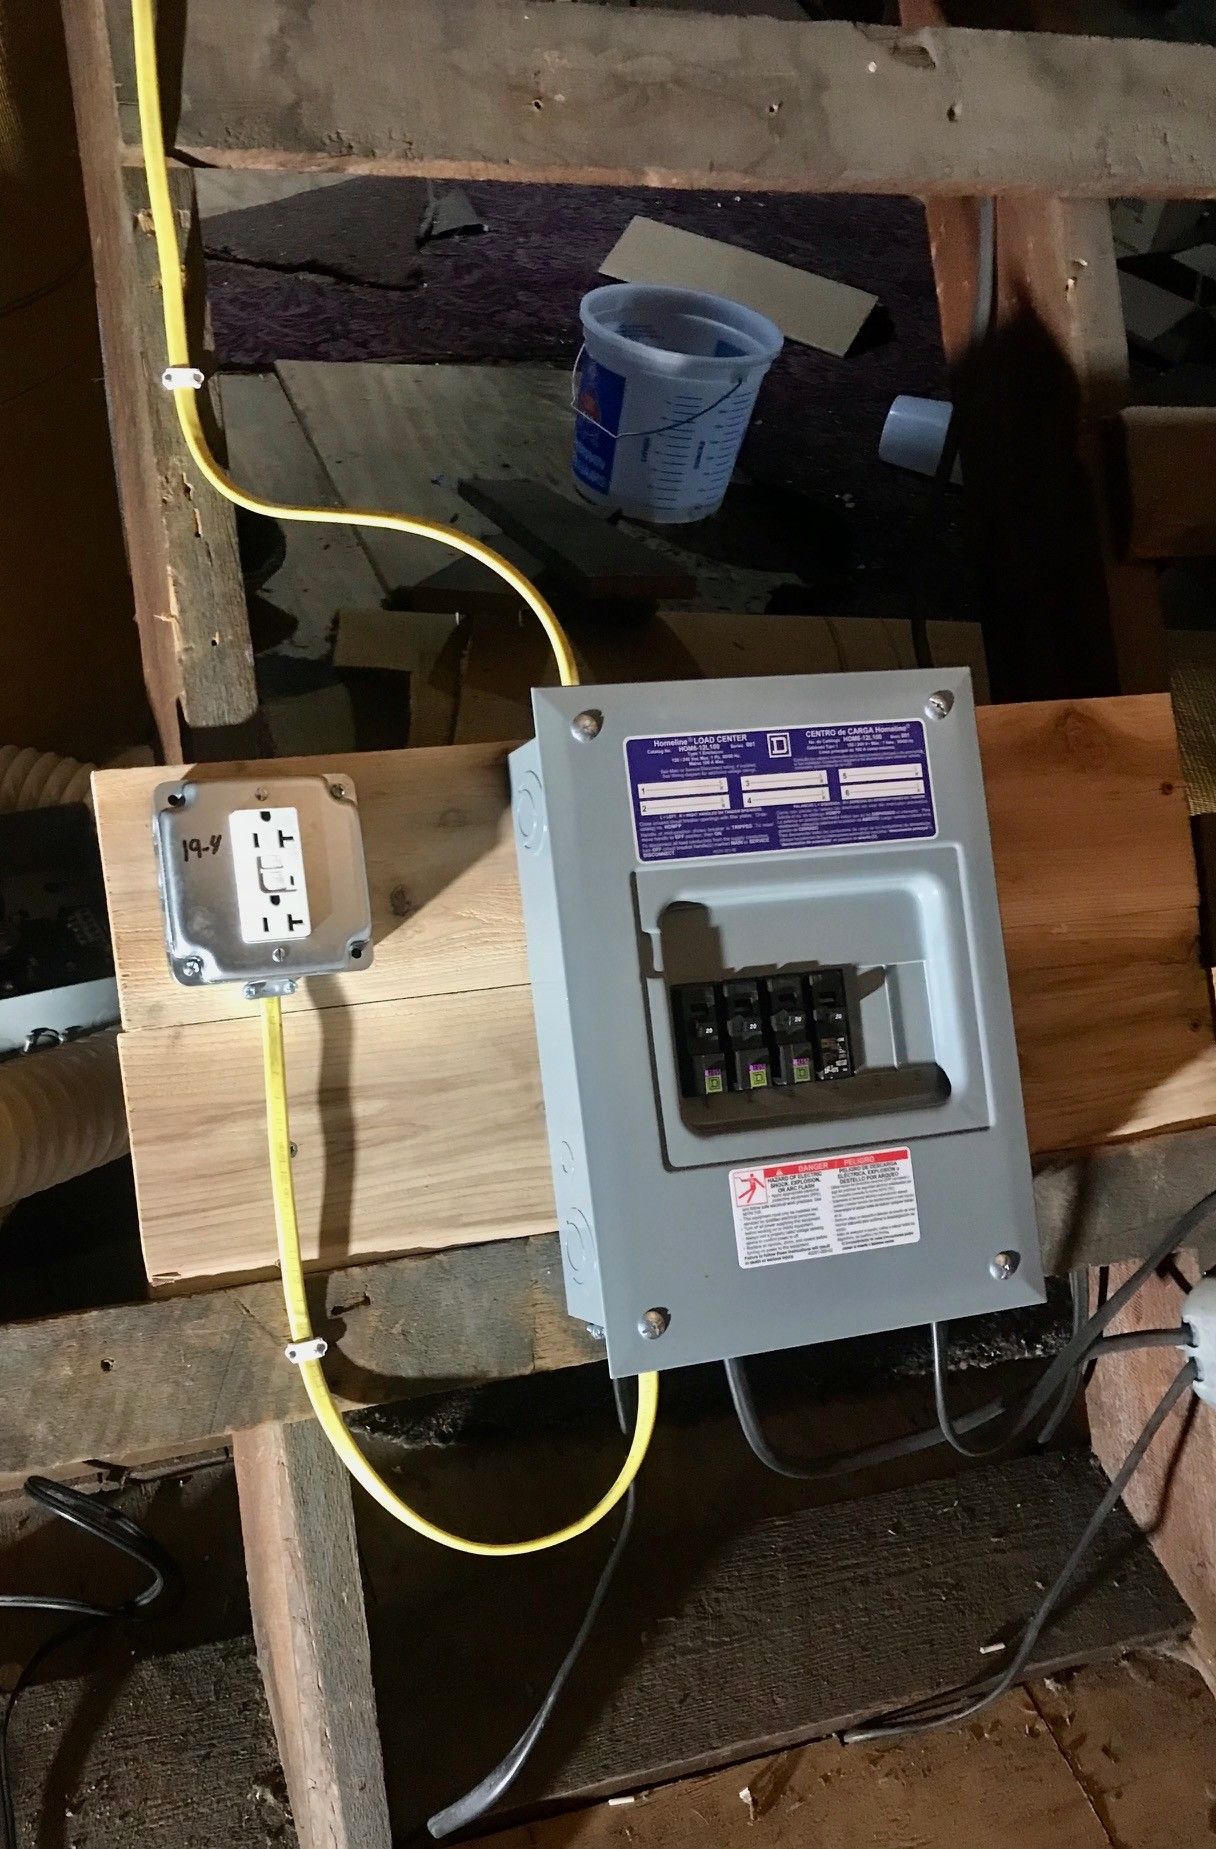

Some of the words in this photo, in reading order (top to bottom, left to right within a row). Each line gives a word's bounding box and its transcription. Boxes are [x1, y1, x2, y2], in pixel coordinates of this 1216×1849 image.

[806, 730, 836, 738] CENTRO
[847, 727, 874, 735] CARGA
[653, 739, 688, 747] Homeline
[694, 736, 715, 744] LOAD
[717, 734, 748, 743] CENTER
[844, 1156, 875, 1166] PELIGRO
[798, 1162, 829, 1172] DANGER
